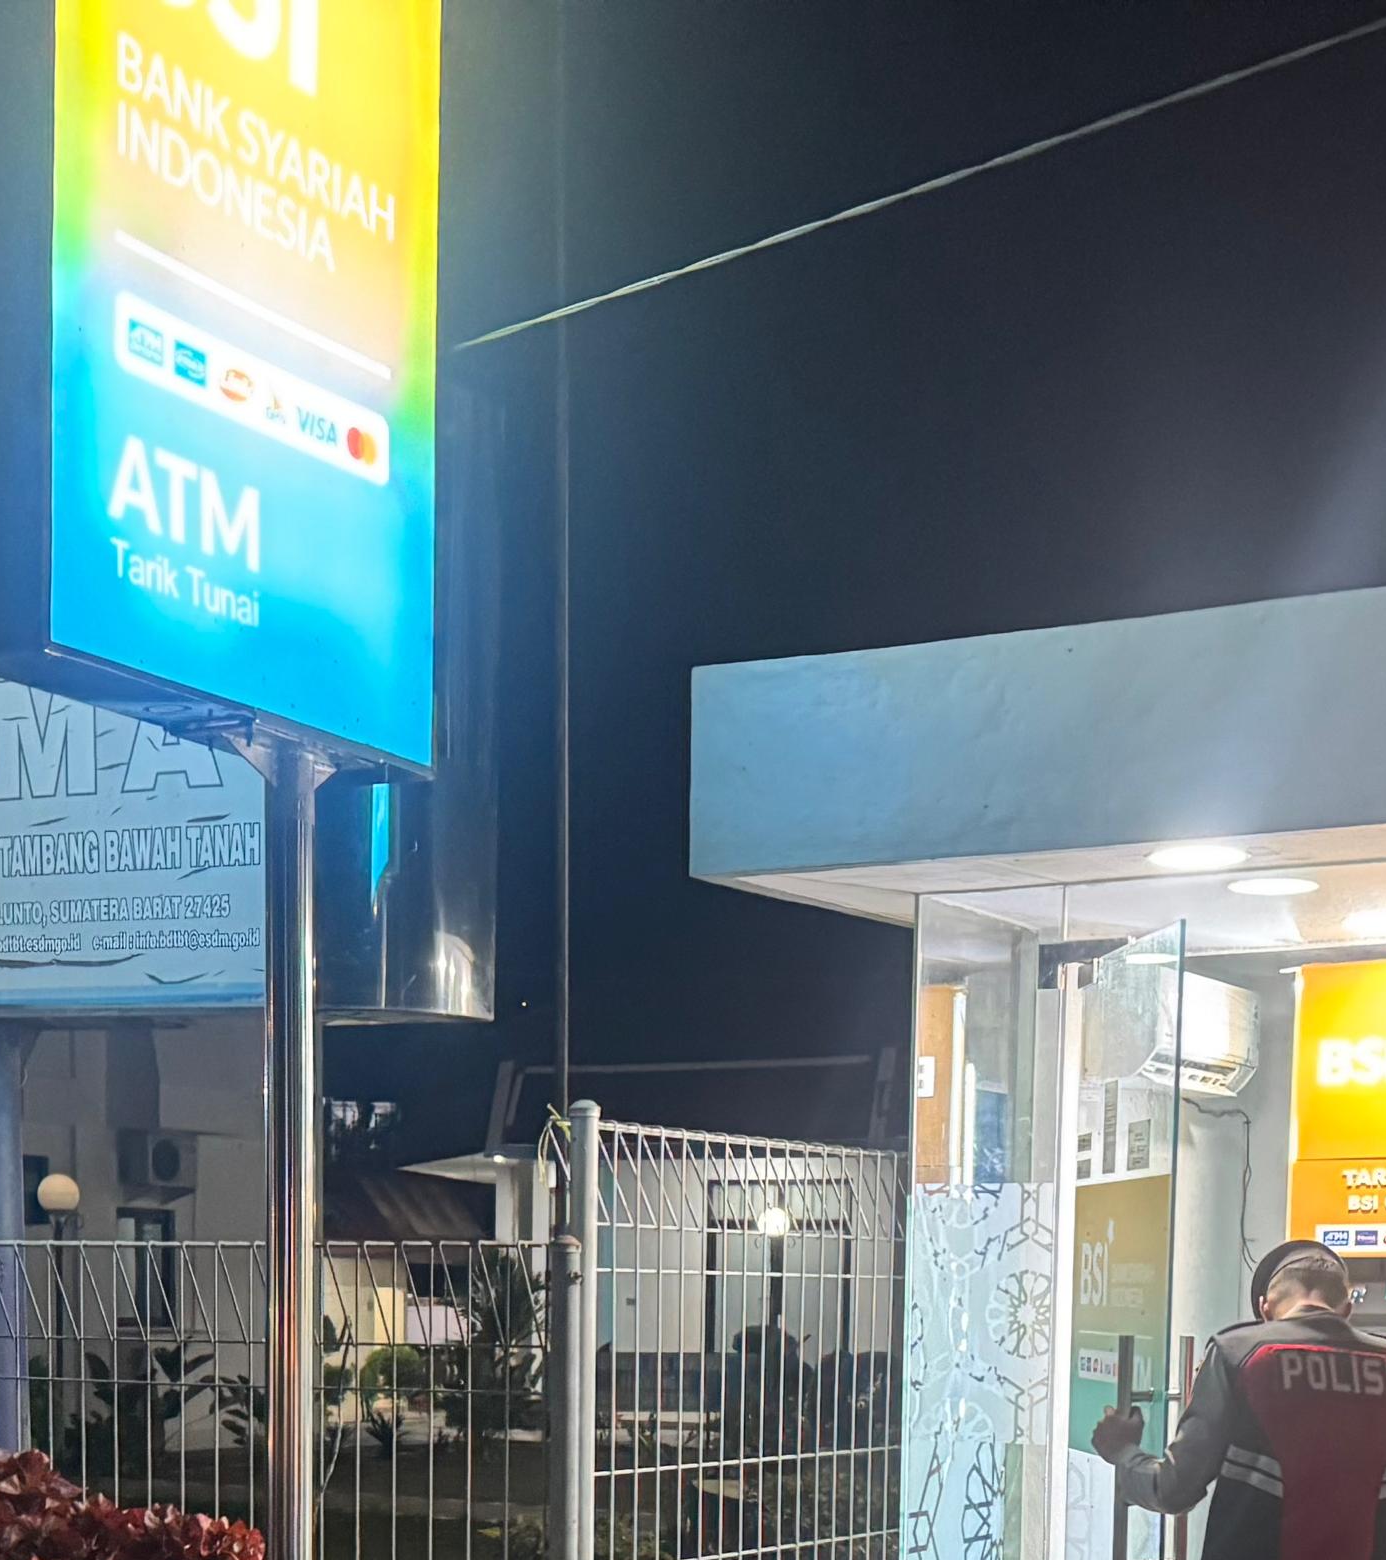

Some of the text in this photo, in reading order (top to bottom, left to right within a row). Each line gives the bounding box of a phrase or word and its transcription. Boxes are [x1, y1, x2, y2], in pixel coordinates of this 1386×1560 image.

[117, 31, 230, 152] BANK
[238, 109, 394, 242] SYARIAH
[118, 103, 335, 272] INDONESIA
[295, 407, 338, 446] VISA
[107, 433, 261, 573] ATM
[110, 537, 260, 628] Tarik Tunai
[104, 825, 182, 873] BAWAH
[186, 822, 261, 868] TANAH
[50, 897, 130, 924] SUMATERA
[132, 894, 183, 920] BARAT
[184, 893, 231, 919] 27425
[1348, 1194, 1380, 1213] BSI
